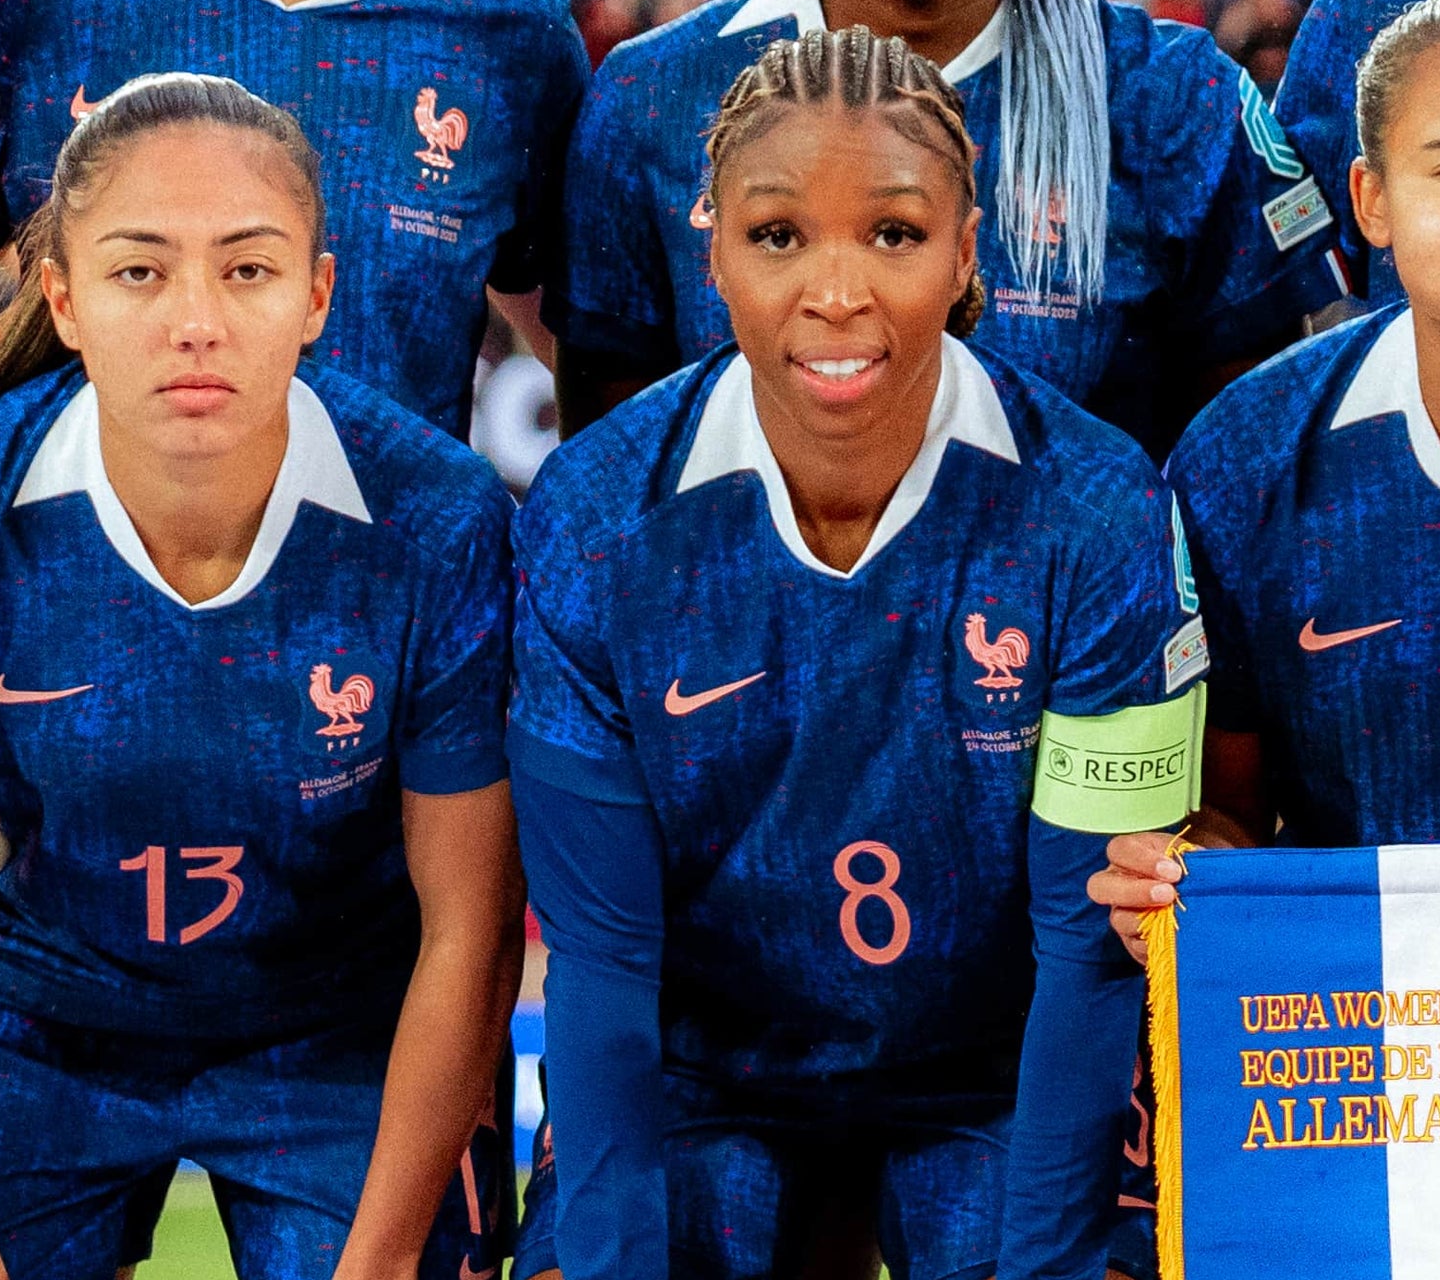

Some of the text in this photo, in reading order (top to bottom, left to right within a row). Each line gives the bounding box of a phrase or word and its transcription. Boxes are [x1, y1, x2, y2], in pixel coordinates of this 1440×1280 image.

[1051, 308, 1078, 320] 2025
[986, 692, 1020, 703] FFF
[962, 730, 1011, 740] ALLEMAGNE
[966, 742, 979, 751] 24
[981, 741, 1021, 752] OCTOBRE
[1085, 748, 1186, 782] RESPECT
[119, 845, 245, 945] 13
[832, 840, 911, 965] 8
[1240, 994, 1328, 1033] UEFA
[1240, 1044, 1374, 1089] EQUIPE
[1381, 1043, 1431, 1081] DE
